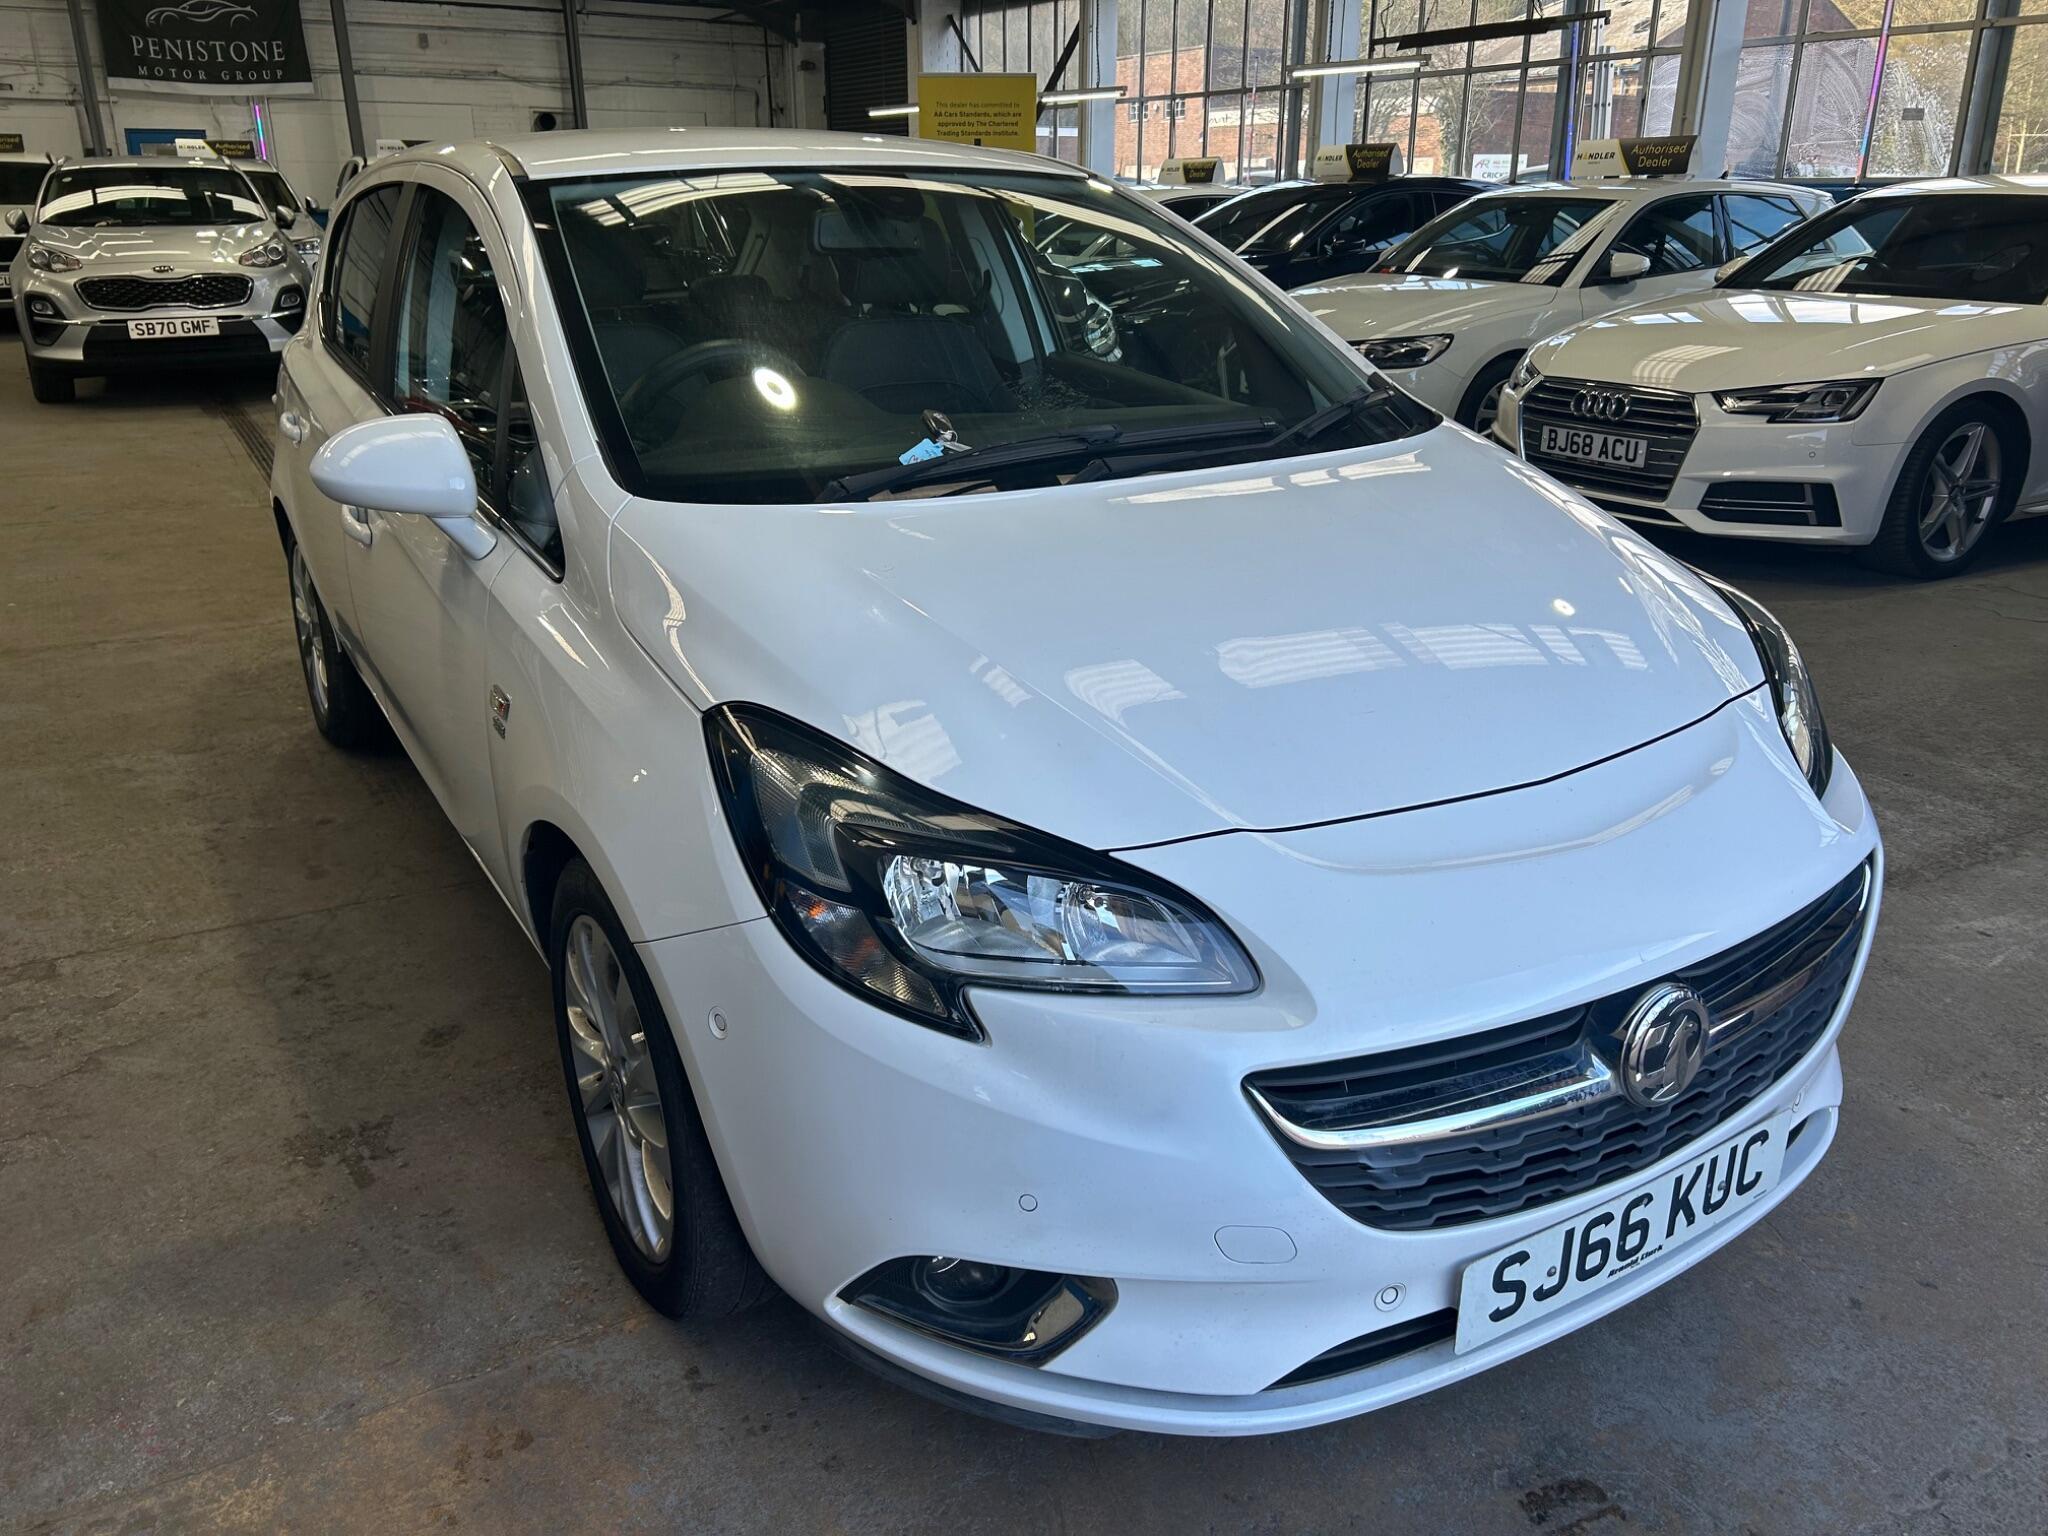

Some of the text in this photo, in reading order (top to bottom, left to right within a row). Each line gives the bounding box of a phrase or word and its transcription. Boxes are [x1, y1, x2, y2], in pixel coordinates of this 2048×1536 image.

[130, 34, 286, 63] PENISTONE
[138, 65, 284, 81] MOTOR GROUP
[1630, 142, 1689, 155] Authorised
[1357, 160, 1380, 169] Dealer
[1637, 156, 1673, 168] Dealer
[134, 319, 211, 337] SB70 GMF
[1546, 428, 1594, 457] BJ68
[1598, 436, 1640, 463] ACU
[1488, 1128, 1770, 1323] SJ66 KUC
